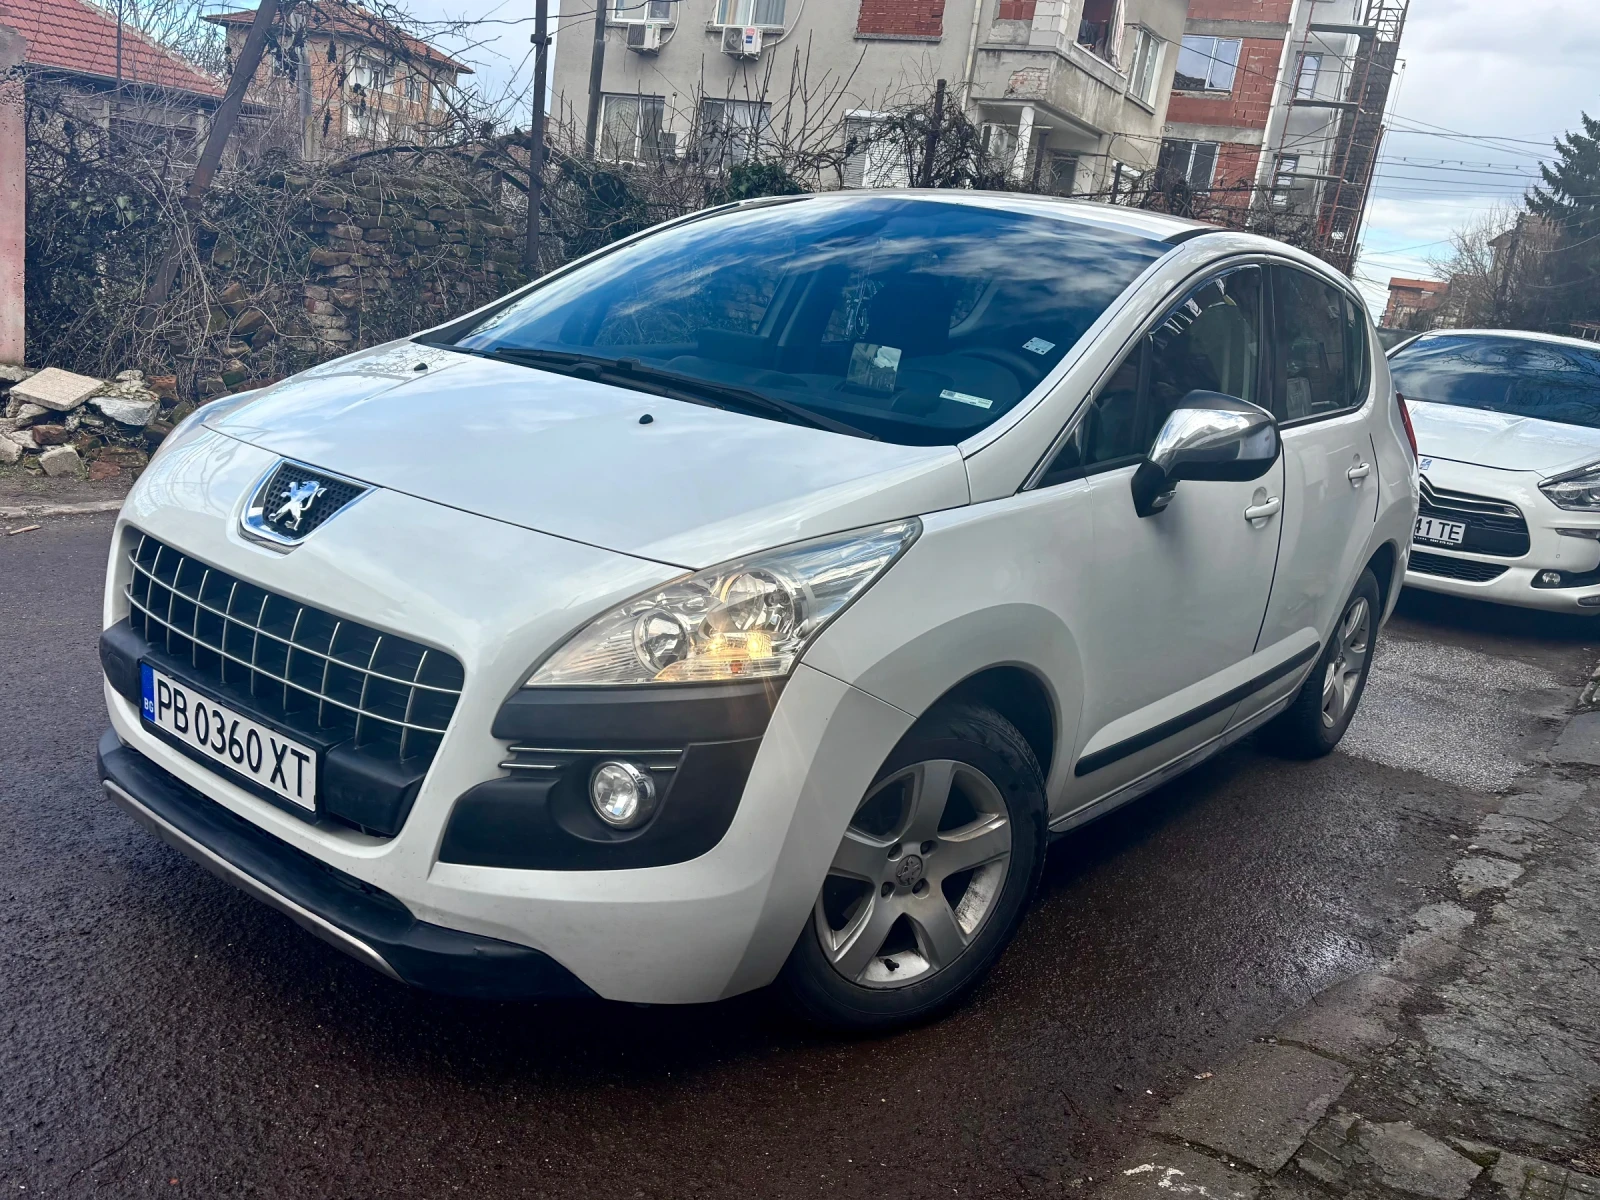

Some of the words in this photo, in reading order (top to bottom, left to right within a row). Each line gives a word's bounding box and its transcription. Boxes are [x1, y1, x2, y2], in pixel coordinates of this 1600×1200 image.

[1439, 521, 1462, 541] TE
[144, 697, 154, 713] BG
[158, 678, 189, 734] PB
[195, 702, 262, 773] 0360
[270, 737, 309, 798] XT
